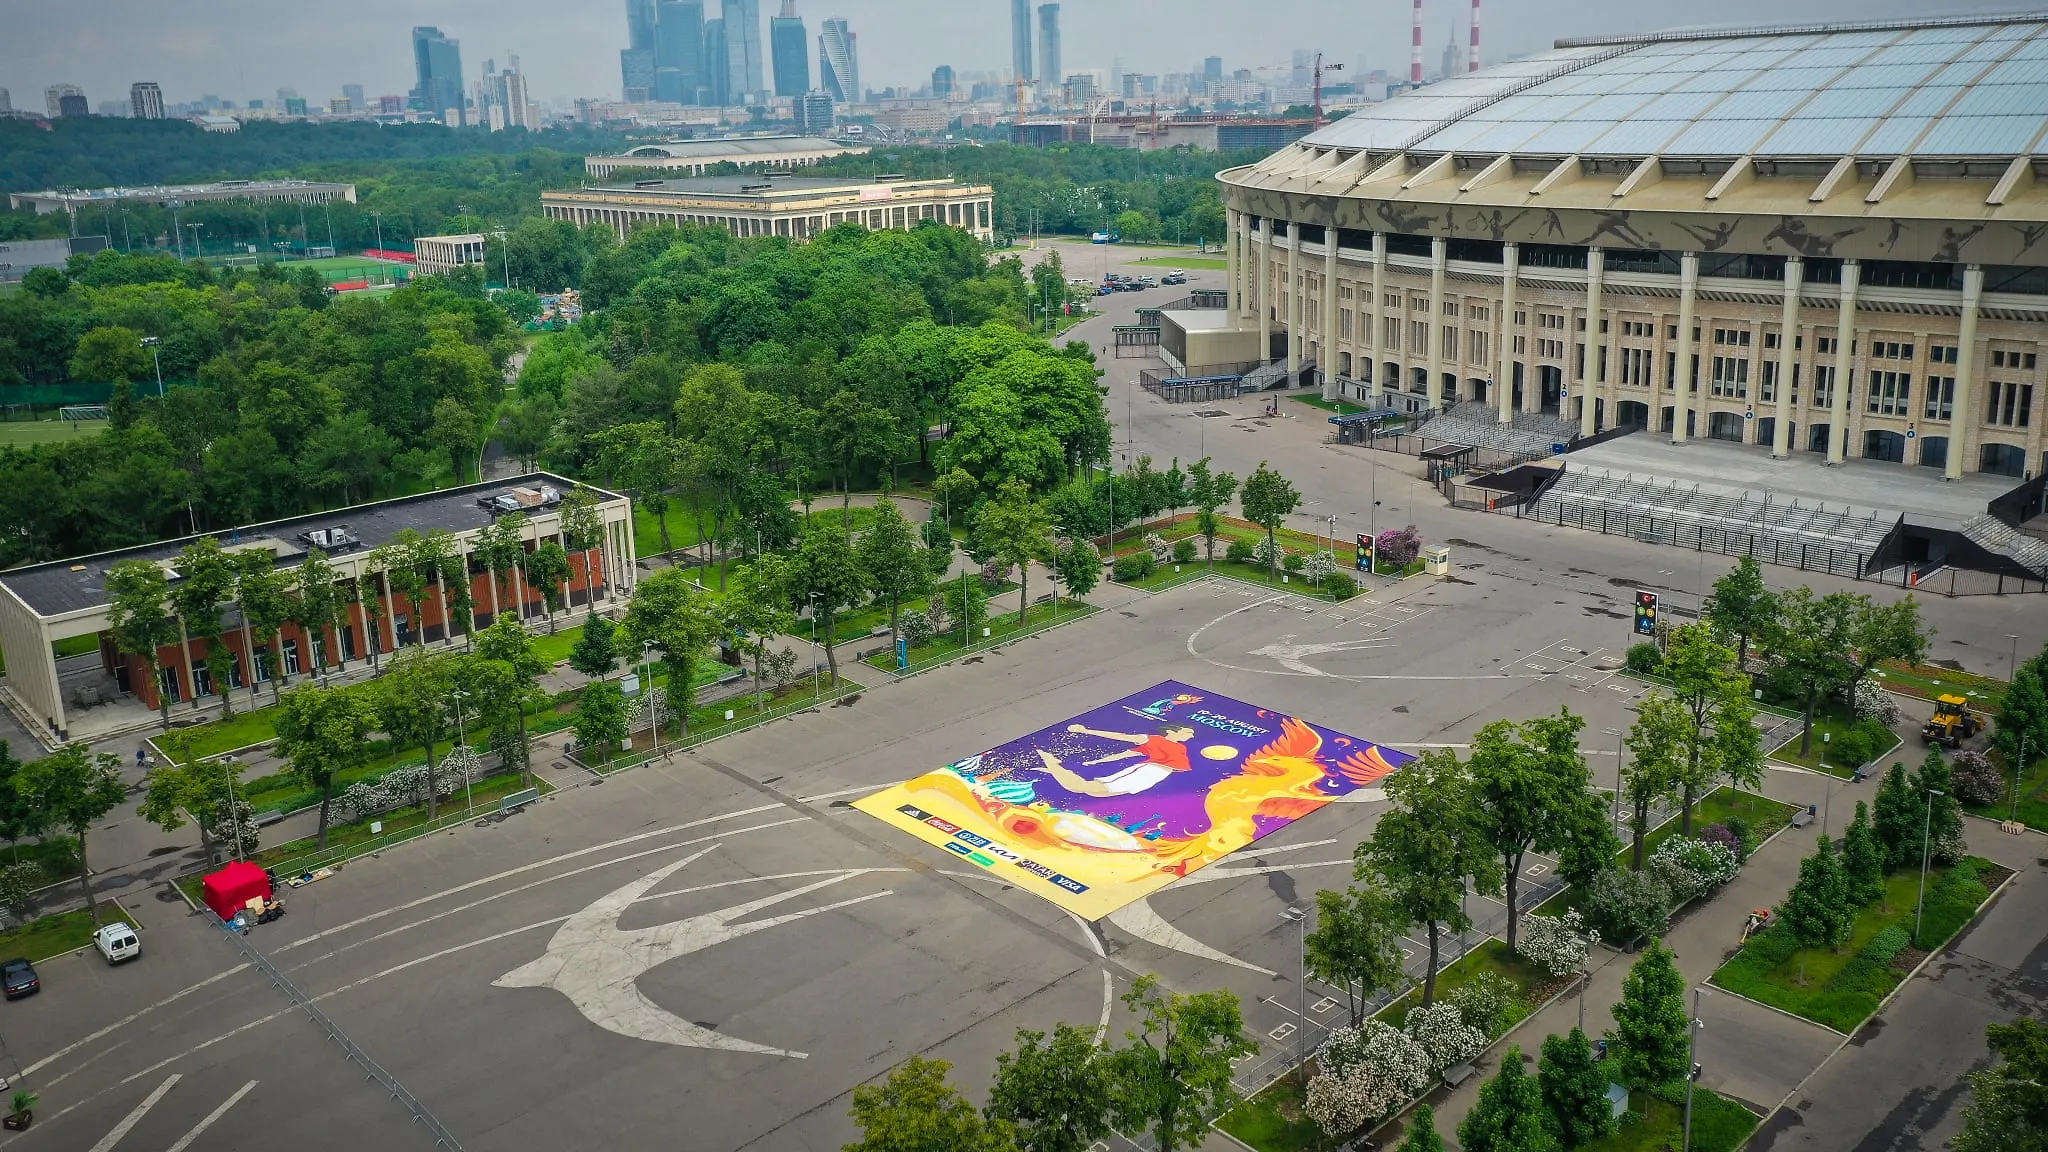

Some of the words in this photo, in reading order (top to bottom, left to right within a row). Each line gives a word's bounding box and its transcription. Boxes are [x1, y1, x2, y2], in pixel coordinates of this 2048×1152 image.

[1187, 713, 1260, 737] MOSCOW
[1225, 719, 1270, 733] AUGUST
[1057, 877, 1081, 891] VISA
